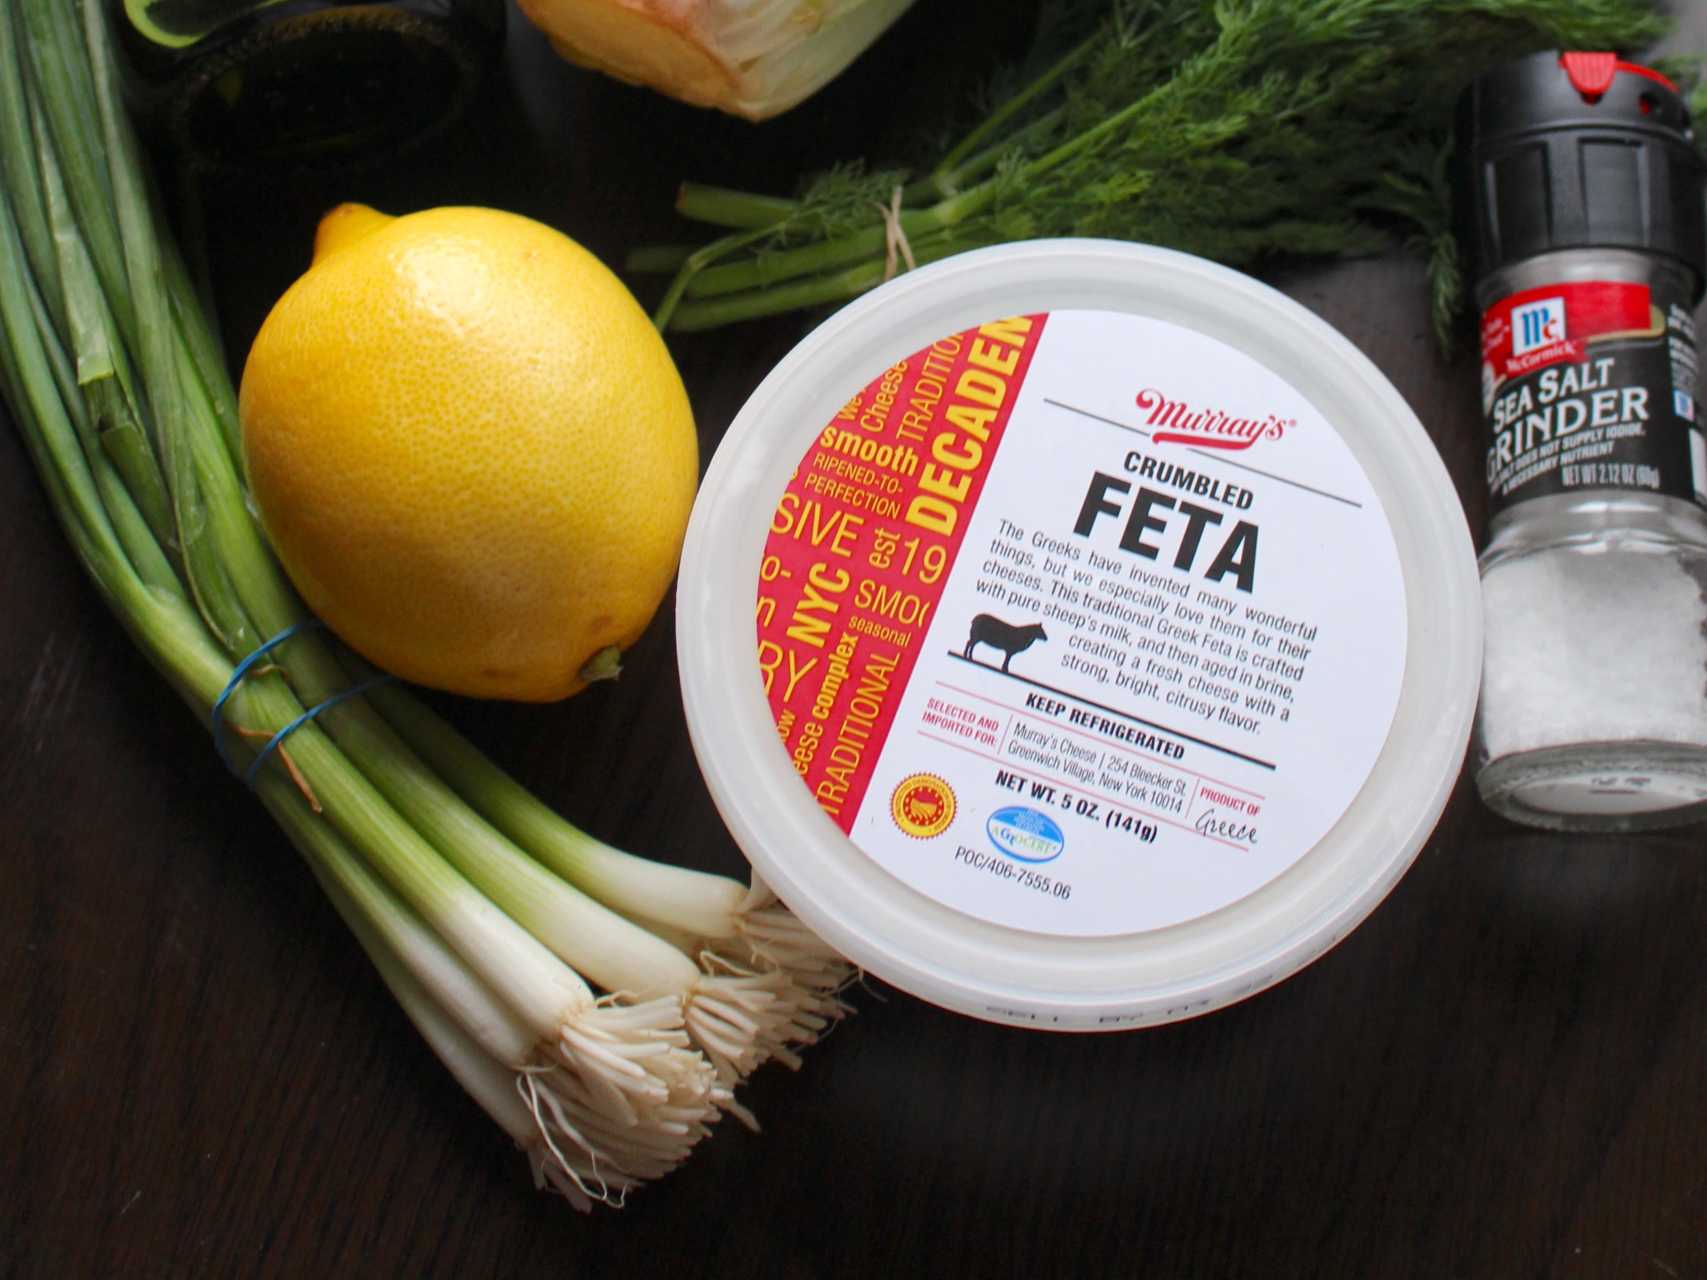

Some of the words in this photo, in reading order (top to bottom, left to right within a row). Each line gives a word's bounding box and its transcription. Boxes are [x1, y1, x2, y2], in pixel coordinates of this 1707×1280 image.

[895, 332, 965, 443] TRADITIO
[1135, 387, 1288, 451] Murray's
[1493, 384, 1534, 435] SEA
[1538, 357, 1616, 405] SALT
[812, 451, 904, 495] RIPENED-TO-
[819, 424, 920, 477] smooth
[1539, 439, 1561, 460] NOT
[1561, 428, 1605, 452] SUPPLY
[1559, 439, 1616, 466] NUTRIENT
[1562, 463, 1580, 488] NET
[804, 474, 901, 521] PERFECTION
[1122, 450, 1255, 512] CRUMBLED
[770, 492, 866, 559] SIVE
[868, 526, 901, 570] est
[1072, 469, 1260, 596] FETA
[901, 536, 947, 586] 19
[998, 518, 1025, 542] The
[1031, 530, 1082, 561] Greeks
[1087, 550, 1123, 575] have
[1128, 565, 1191, 599] invented
[1195, 590, 1238, 617] many
[1244, 606, 1318, 642] wonderful
[786, 562, 851, 649] NYC
[848, 615, 912, 649] seasonal
[982, 559, 1043, 593] cheeses.
[1050, 579, 1080, 604] This
[1081, 591, 1156, 630] traditional
[1156, 617, 1200, 646] Greek
[1201, 632, 1233, 659] Feta
[1234, 645, 1249, 663] is
[1251, 653, 1305, 682] crafted
[989, 538, 1036, 569] things,
[1042, 555, 1068, 578] but
[1072, 569, 1094, 587] we
[1098, 579, 1170, 615] especially
[1173, 601, 1205, 625] love
[1209, 614, 1247, 640] them
[1250, 628, 1272, 649] for
[1277, 637, 1312, 662] their
[975, 578, 1007, 601] with
[1006, 590, 1042, 613] pure
[1042, 602, 1098, 633] sheep's
[1098, 622, 1133, 647] milk,
[1136, 636, 1167, 657] and
[1166, 643, 1200, 669] then
[1200, 658, 1239, 682] aged
[1238, 667, 1254, 687] in
[1254, 673, 1295, 704] brine,
[811, 631, 859, 721] complex
[1060, 654, 1110, 684] strong,
[1114, 669, 1160, 702] bright,
[1165, 690, 1217, 721] citrusy
[1217, 705, 1263, 735] flavor.
[1068, 634, 1128, 668] creating
[1130, 656, 1142, 671] a
[1145, 658, 1184, 685] fresh
[1187, 675, 1240, 705] cheese
[1244, 694, 1277, 717] with
[1279, 707, 1291, 723] a
[926, 697, 977, 724] SELECTED
[976, 715, 1000, 733] AND
[1024, 691, 1067, 718] KEEP
[1067, 707, 1186, 761] REFRIGERATED
[1007, 739, 1061, 771] Greenwich
[1062, 758, 1101, 786] Village,
[1097, 771, 1124, 793] New
[1124, 780, 1148, 802] York
[1149, 789, 1184, 814] 10014
[1013, 721, 1059, 751] Murray's
[1059, 738, 1098, 764] Cheese
[1106, 755, 1130, 775] 254
[1128, 762, 1174, 791] Bleecker
[1172, 778, 1187, 797] St.
[994, 768, 1029, 794] NET
[1029, 780, 1058, 806] WT.
[1059, 792, 1074, 811] 5
[1075, 798, 1101, 822] OZ.
[1104, 808, 1159, 845] (141g)
[1194, 807, 1260, 845] Greece
[1199, 786, 1247, 812] PRODUCT
[1246, 801, 1261, 817] OF
[954, 845, 1072, 901] POC/406-7555.06
